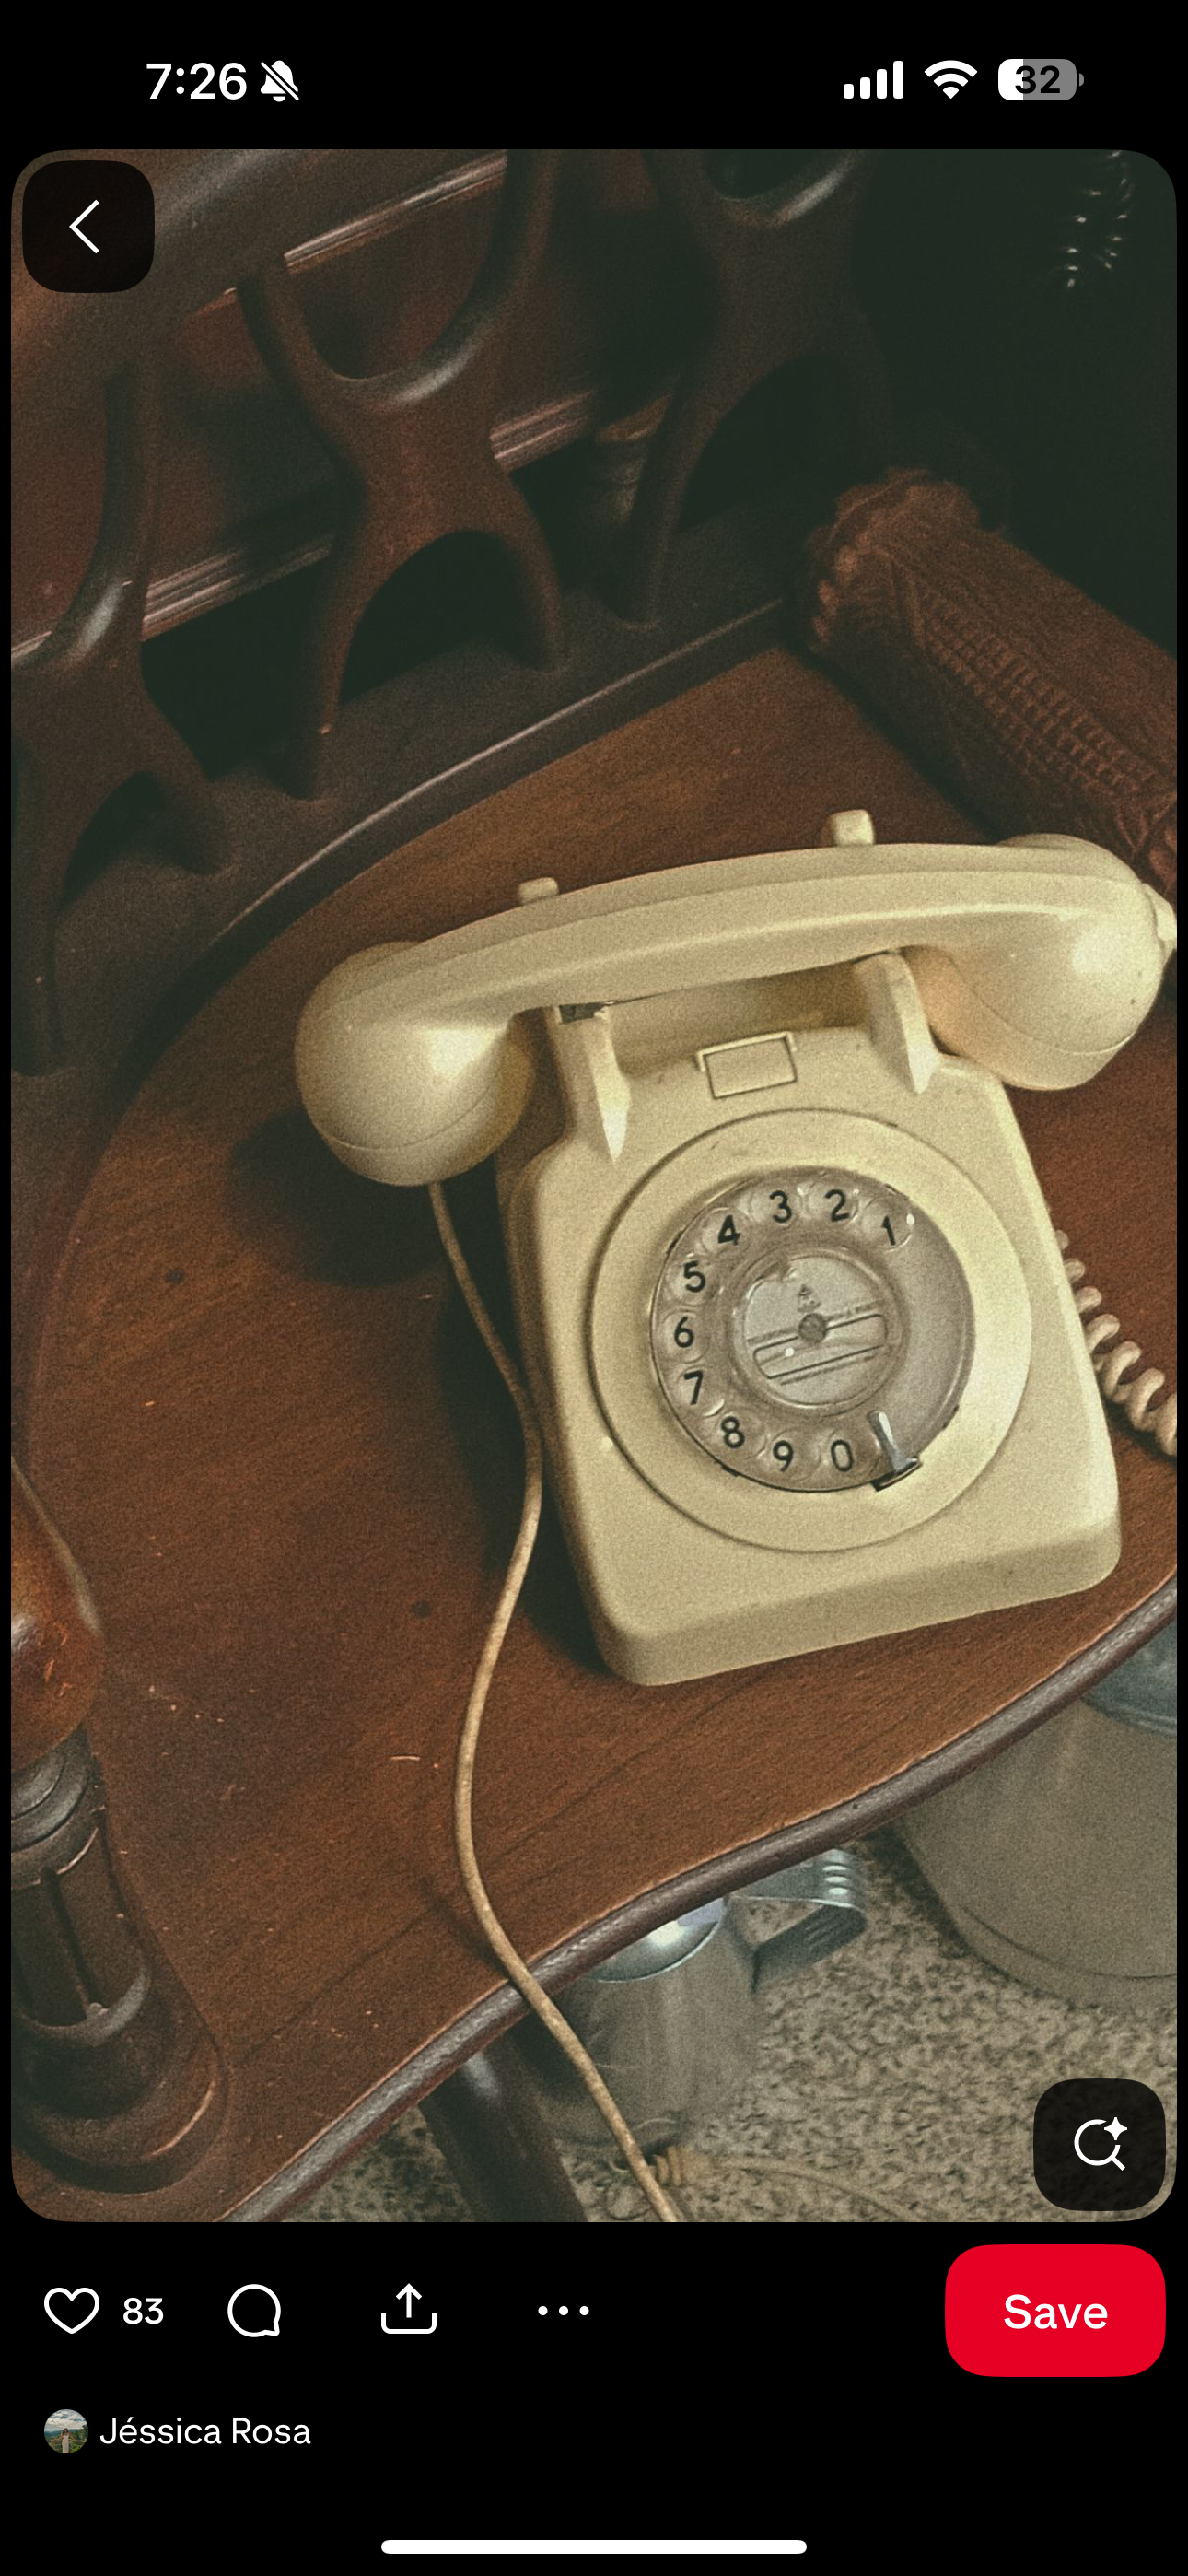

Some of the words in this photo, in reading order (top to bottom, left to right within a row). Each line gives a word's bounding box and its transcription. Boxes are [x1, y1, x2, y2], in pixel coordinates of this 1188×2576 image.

[769, 1190, 792, 1224] 3
[825, 1189, 850, 1223] 2
[717, 1214, 740, 1246] 4
[881, 1215, 897, 1246] 1
[683, 1260, 706, 1294] 5
[673, 1316, 694, 1348] 6
[683, 1370, 704, 1405] 7
[721, 1416, 745, 1449] 8
[773, 1440, 794, 1472] 9
[830, 1439, 855, 1473] 0
